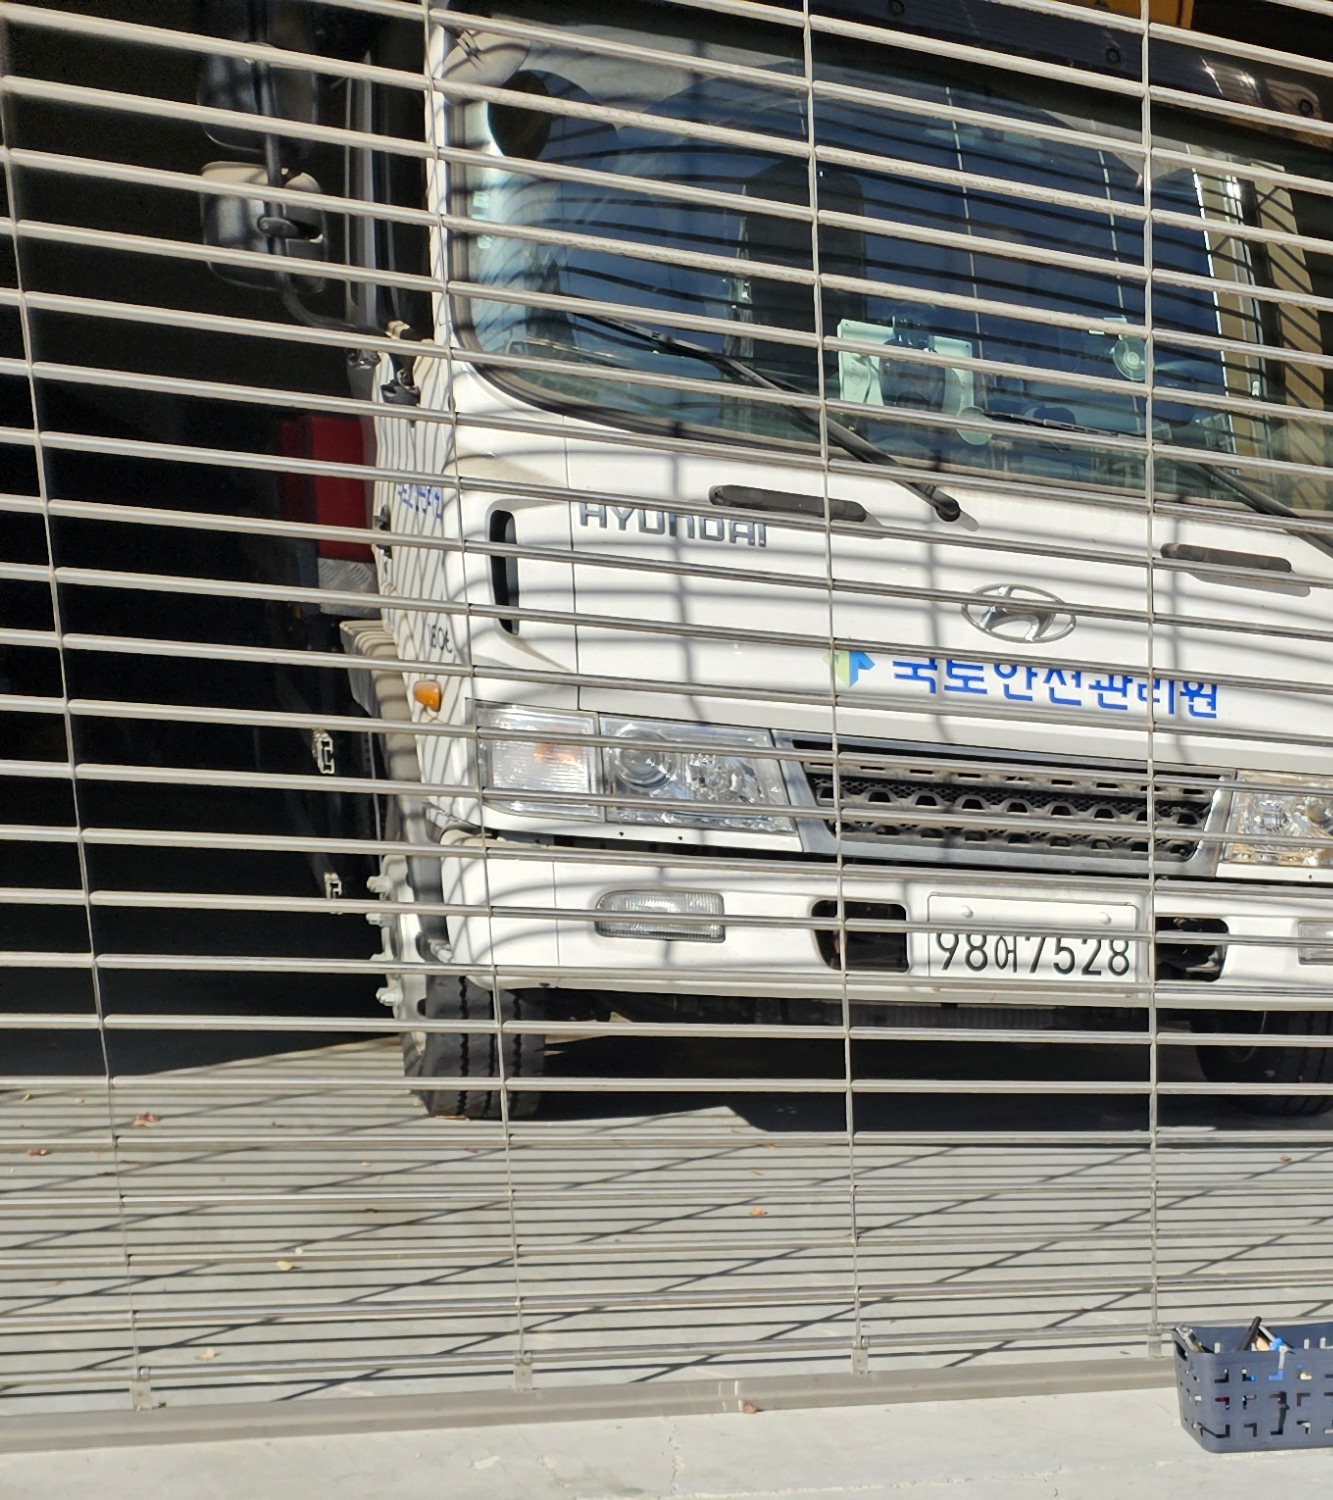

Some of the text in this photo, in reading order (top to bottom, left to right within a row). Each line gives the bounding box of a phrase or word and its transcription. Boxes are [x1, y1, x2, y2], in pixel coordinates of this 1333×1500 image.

[580, 502, 766, 547] HYUNDAI
[892, 659, 1218, 719] 국토안전관리원
[937, 932, 1129, 977] 98어7528
